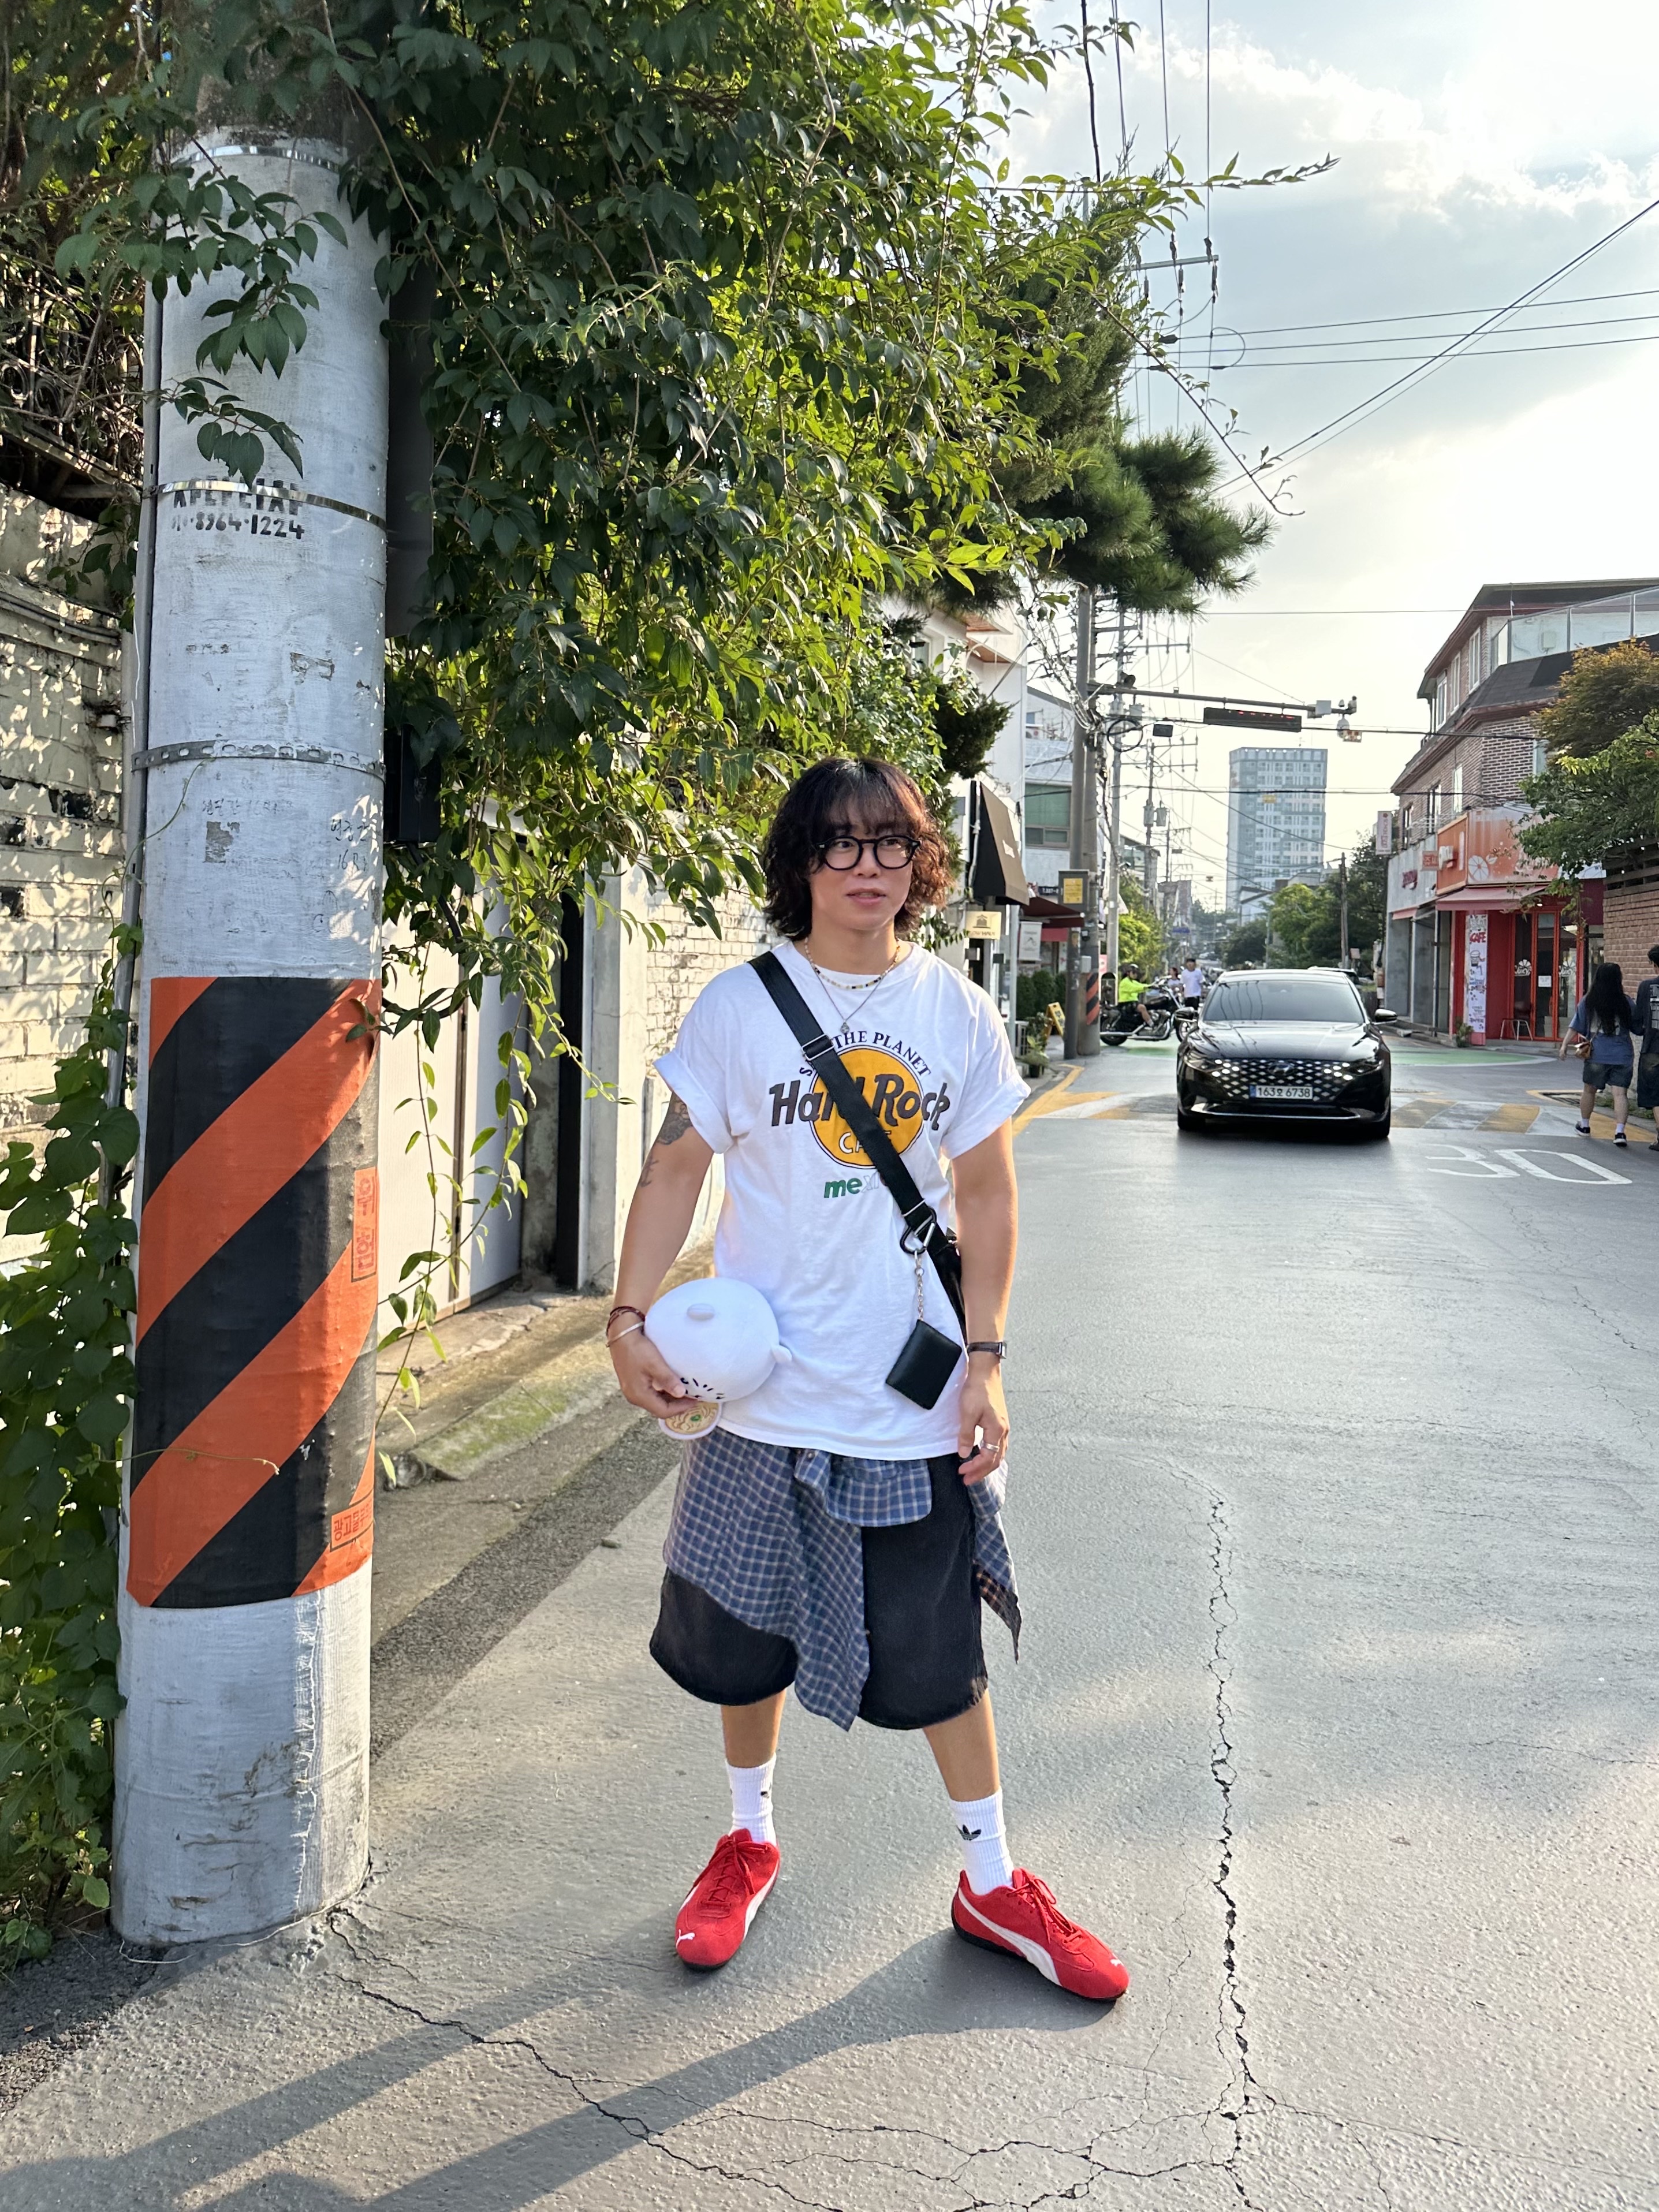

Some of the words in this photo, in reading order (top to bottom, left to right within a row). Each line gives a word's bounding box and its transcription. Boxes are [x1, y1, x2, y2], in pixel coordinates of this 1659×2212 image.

[832, 1031, 867, 1049] THE
[872, 1032, 931, 1076] PLANET
[873, 1074, 950, 1131] Rock
[1285, 1088, 1310, 1098] 6738
[824, 1171, 888, 1199] mexi
[1423, 1143, 1633, 1185] 30
